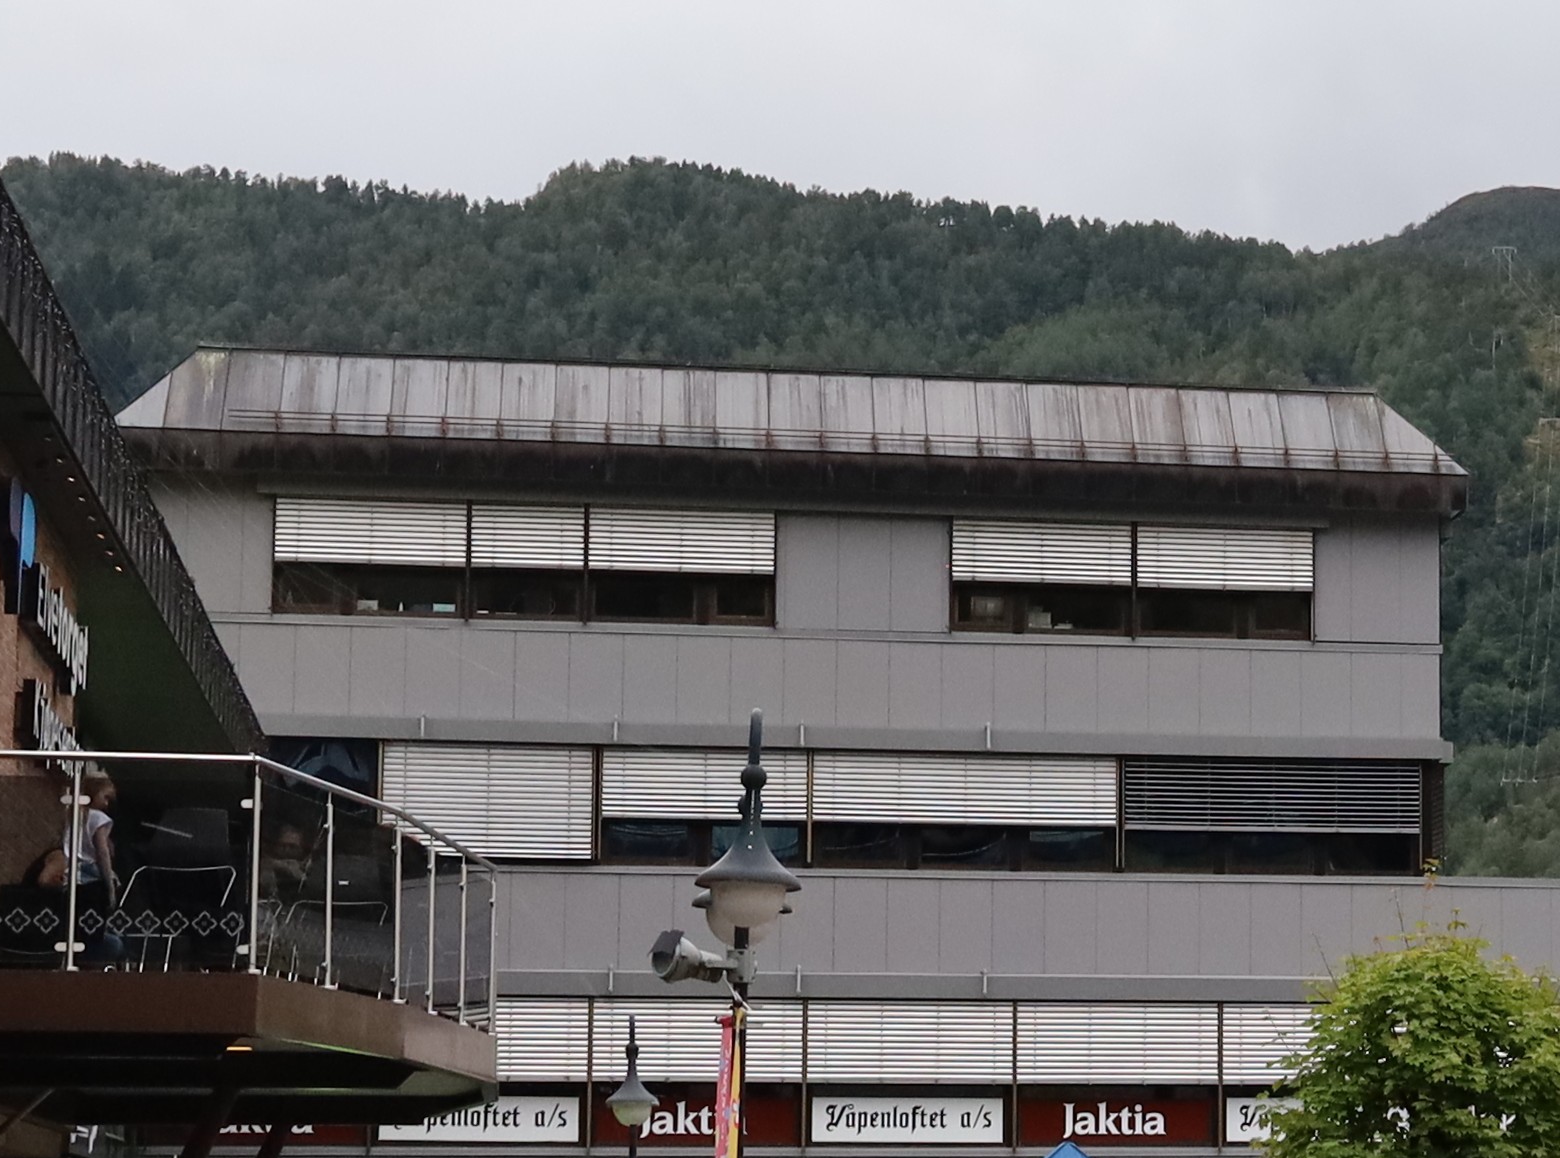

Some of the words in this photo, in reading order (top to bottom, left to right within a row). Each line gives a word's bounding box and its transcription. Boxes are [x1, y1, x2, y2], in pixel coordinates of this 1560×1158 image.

[534, 1103, 568, 1129] a/s
[960, 1104, 992, 1129] a/s
[1063, 1102, 1167, 1140] Jaktia
